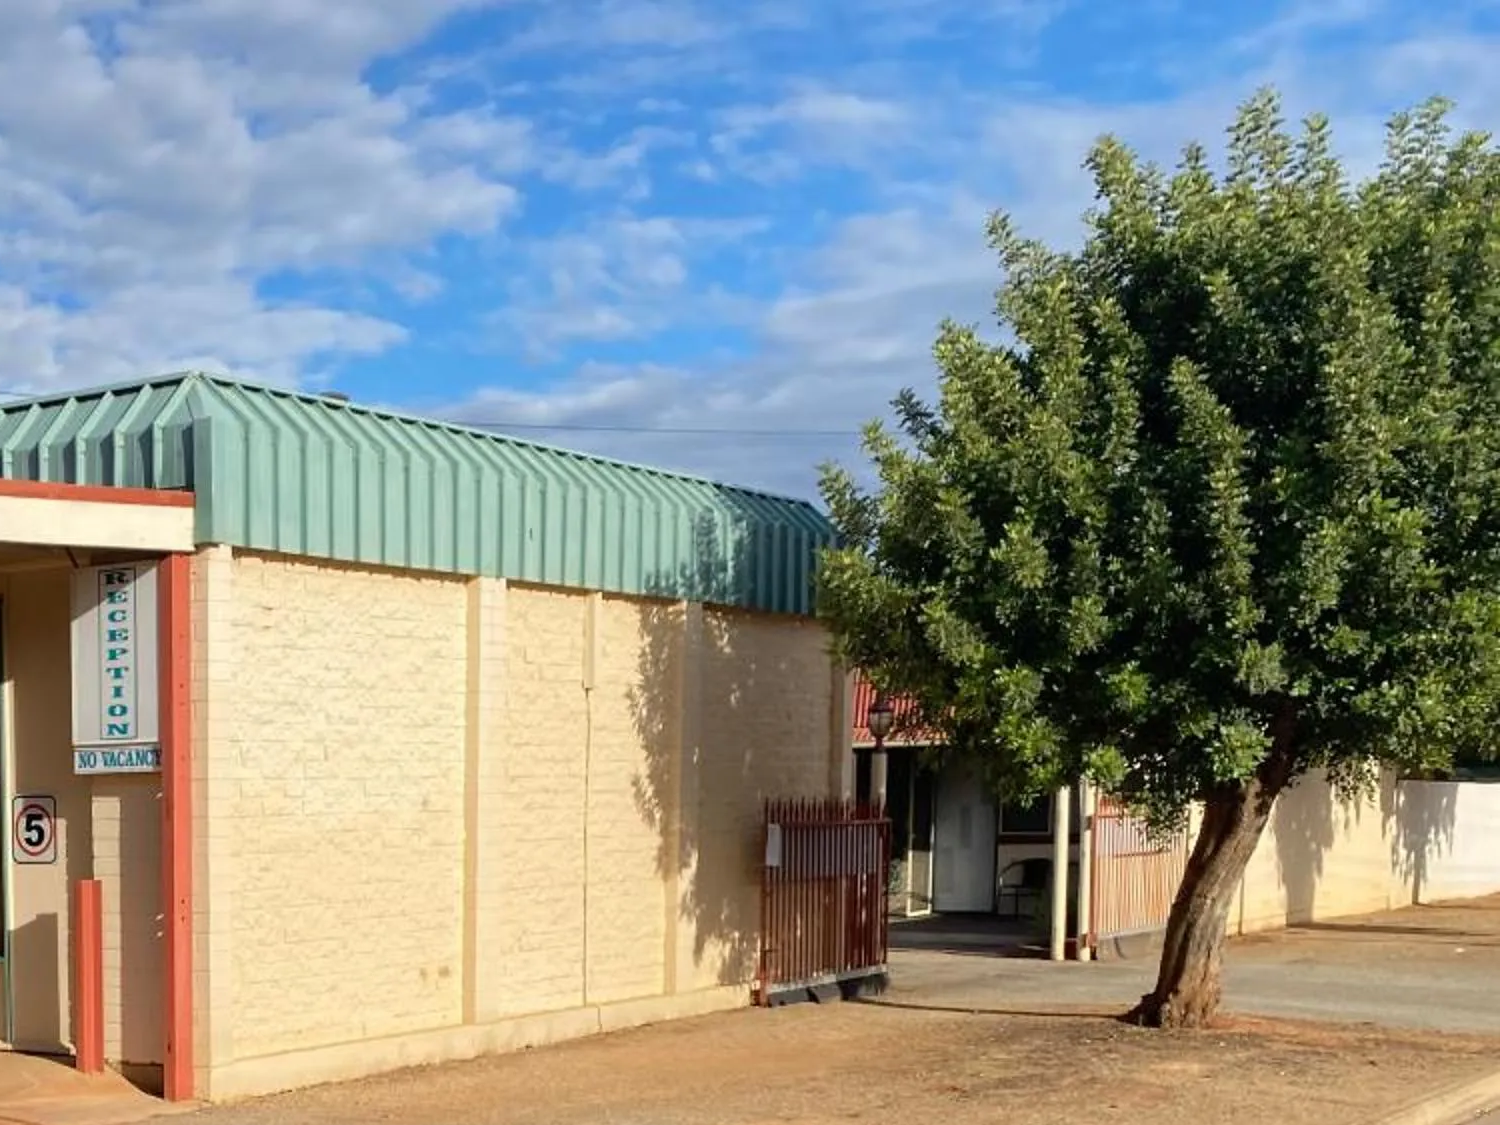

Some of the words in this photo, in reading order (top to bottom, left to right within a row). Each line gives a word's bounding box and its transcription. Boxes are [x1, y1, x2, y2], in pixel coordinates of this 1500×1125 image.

[105, 571, 129, 735] RECEPTION
[78, 751, 97, 769] NO
[24, 814, 45, 847] 5
